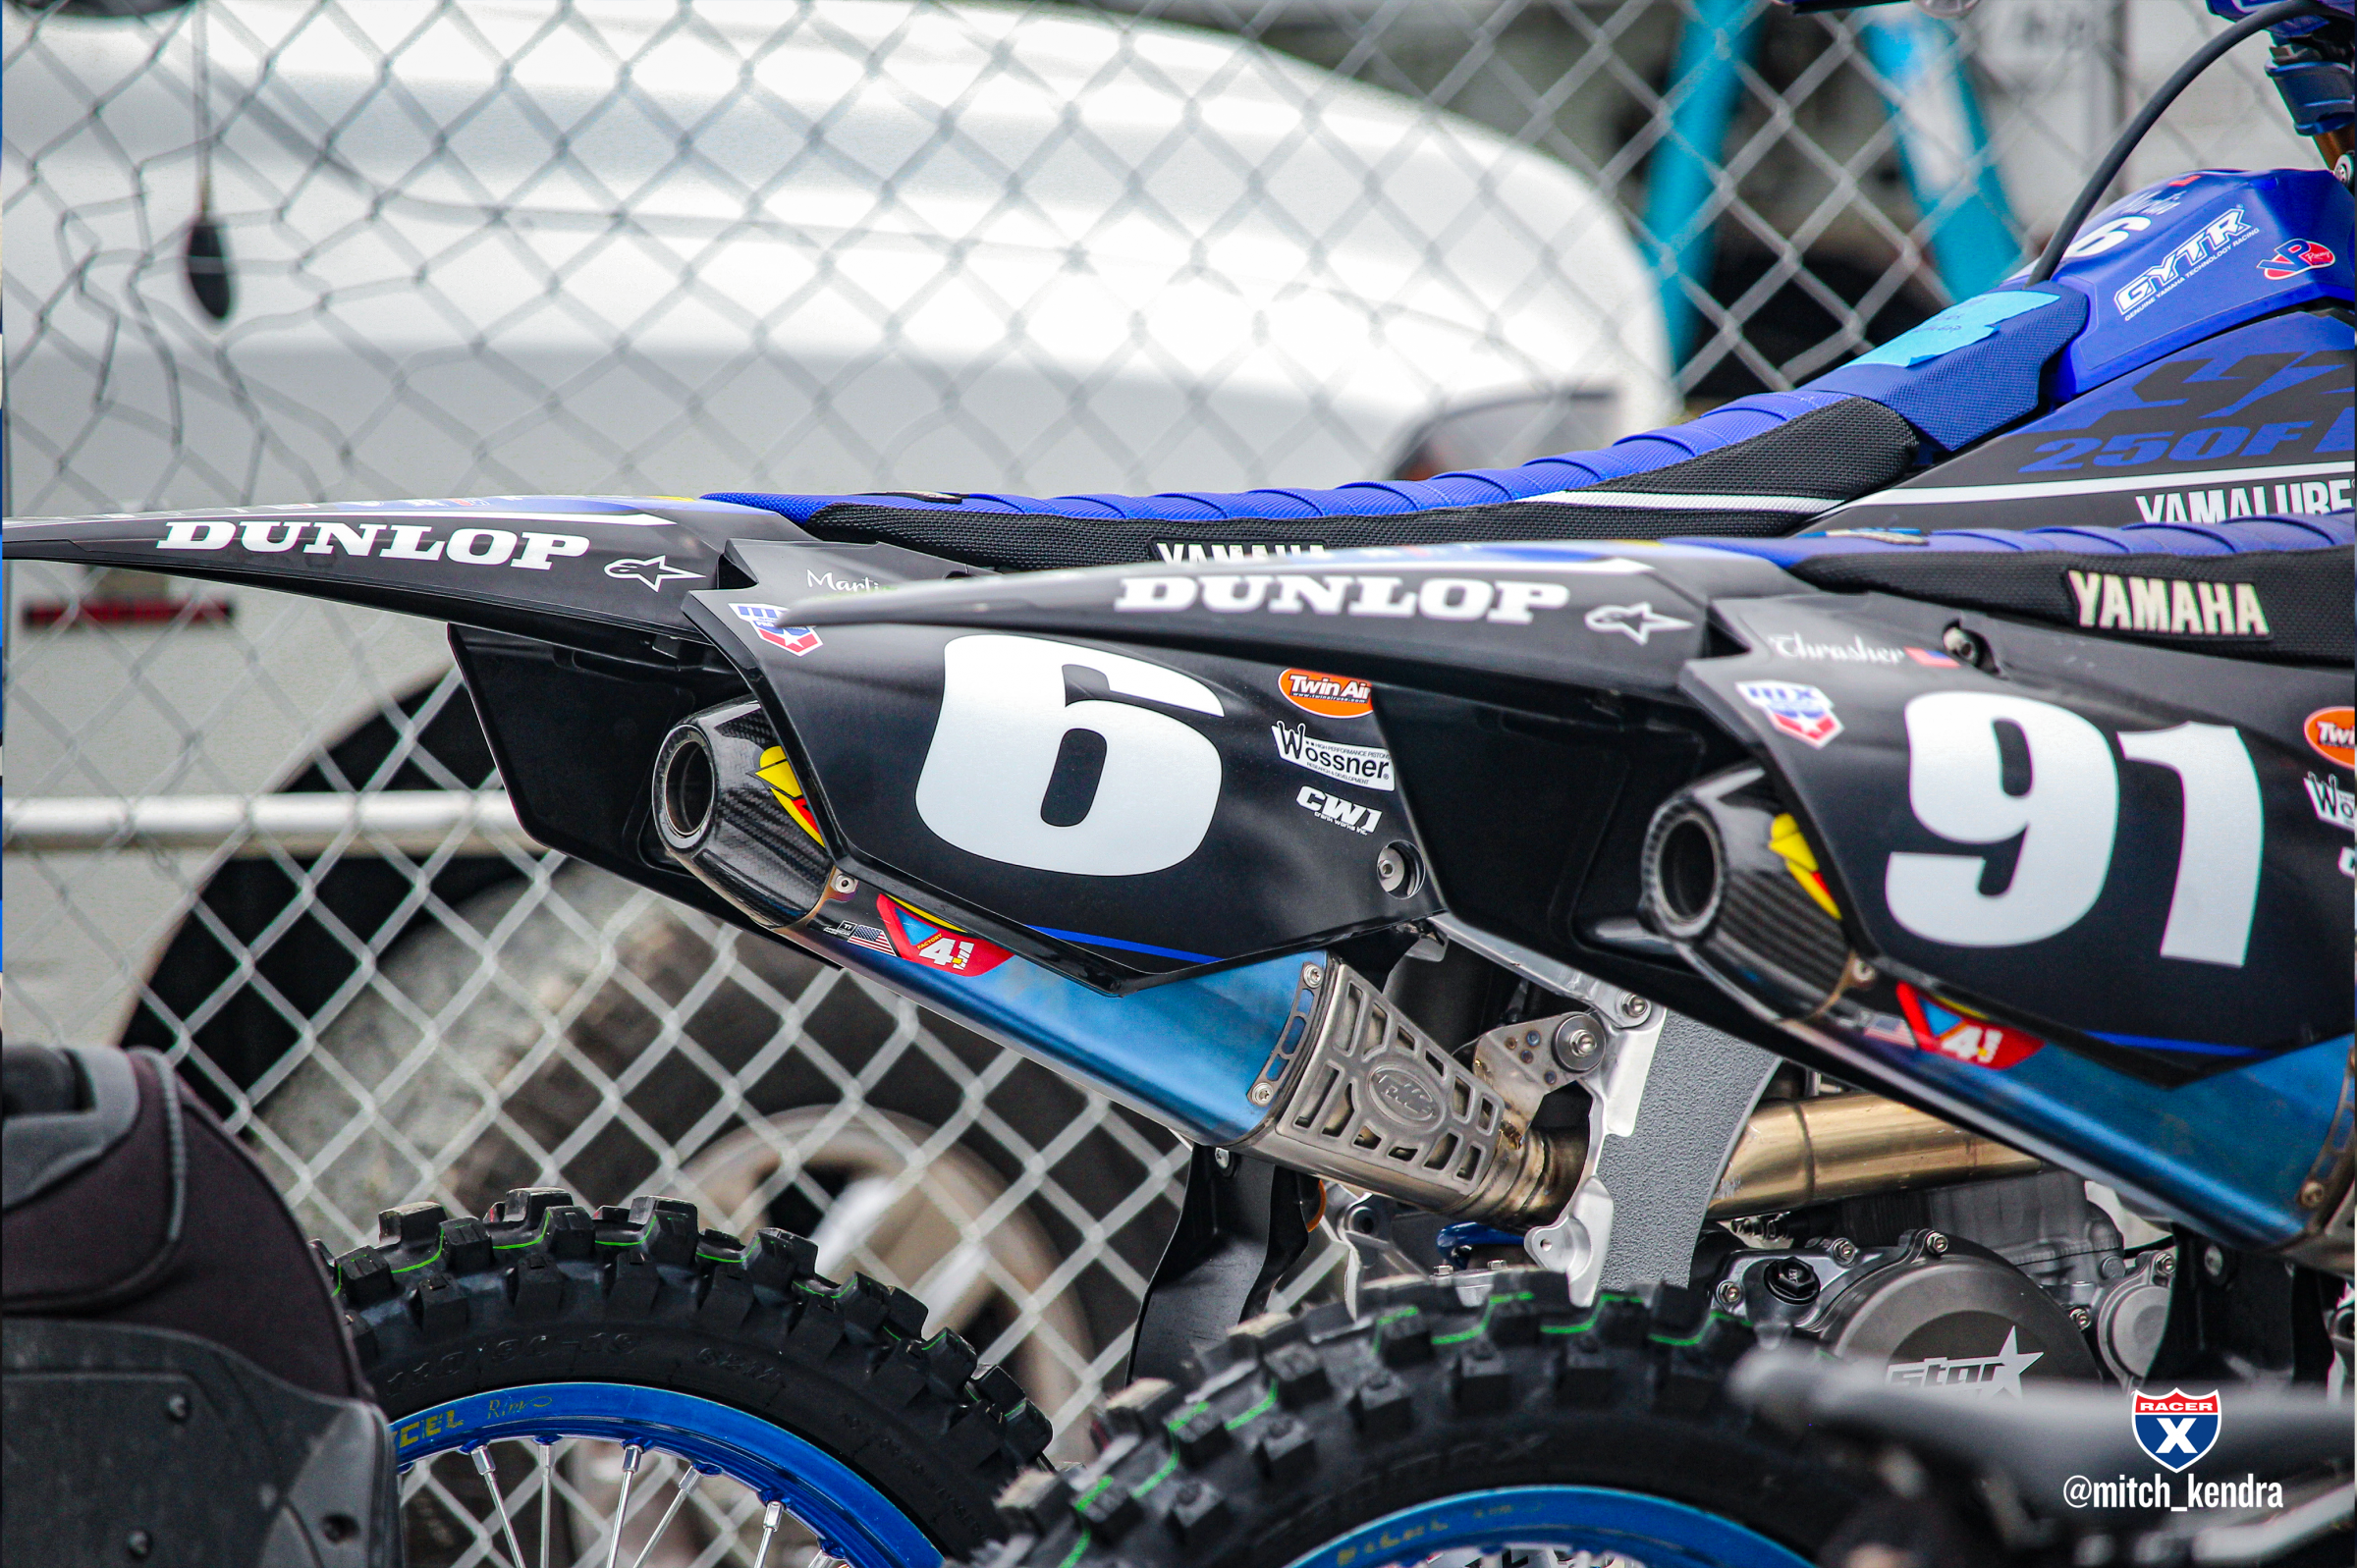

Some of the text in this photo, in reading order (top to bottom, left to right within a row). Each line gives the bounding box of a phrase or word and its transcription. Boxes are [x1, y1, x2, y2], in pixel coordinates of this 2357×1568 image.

[2114, 208, 2252, 315] GYTR
[2125, 227, 2260, 321] GENUINE YAMAHA TECHNOLOGY RACING
[156, 520, 590, 571] DUNLOP
[806, 568, 880, 592] Marti
[1114, 574, 1570, 624] DUNLOP
[2067, 569, 2270, 635] YAMAHA
[1769, 631, 1906, 665] Thrasher
[1289, 675, 1372, 700] Twin Air
[915, 634, 1226, 877] 6
[1278, 721, 1390, 779] Wössner
[1328, 745, 1367, 757] PERFORMANCE
[1336, 772, 1370, 785] DEVELOPMENT
[1295, 785, 1383, 834] CWI
[1885, 690, 2264, 968] 91
[917, 933, 943, 949] FACTORY
[394, 1409, 465, 1448] CEL
